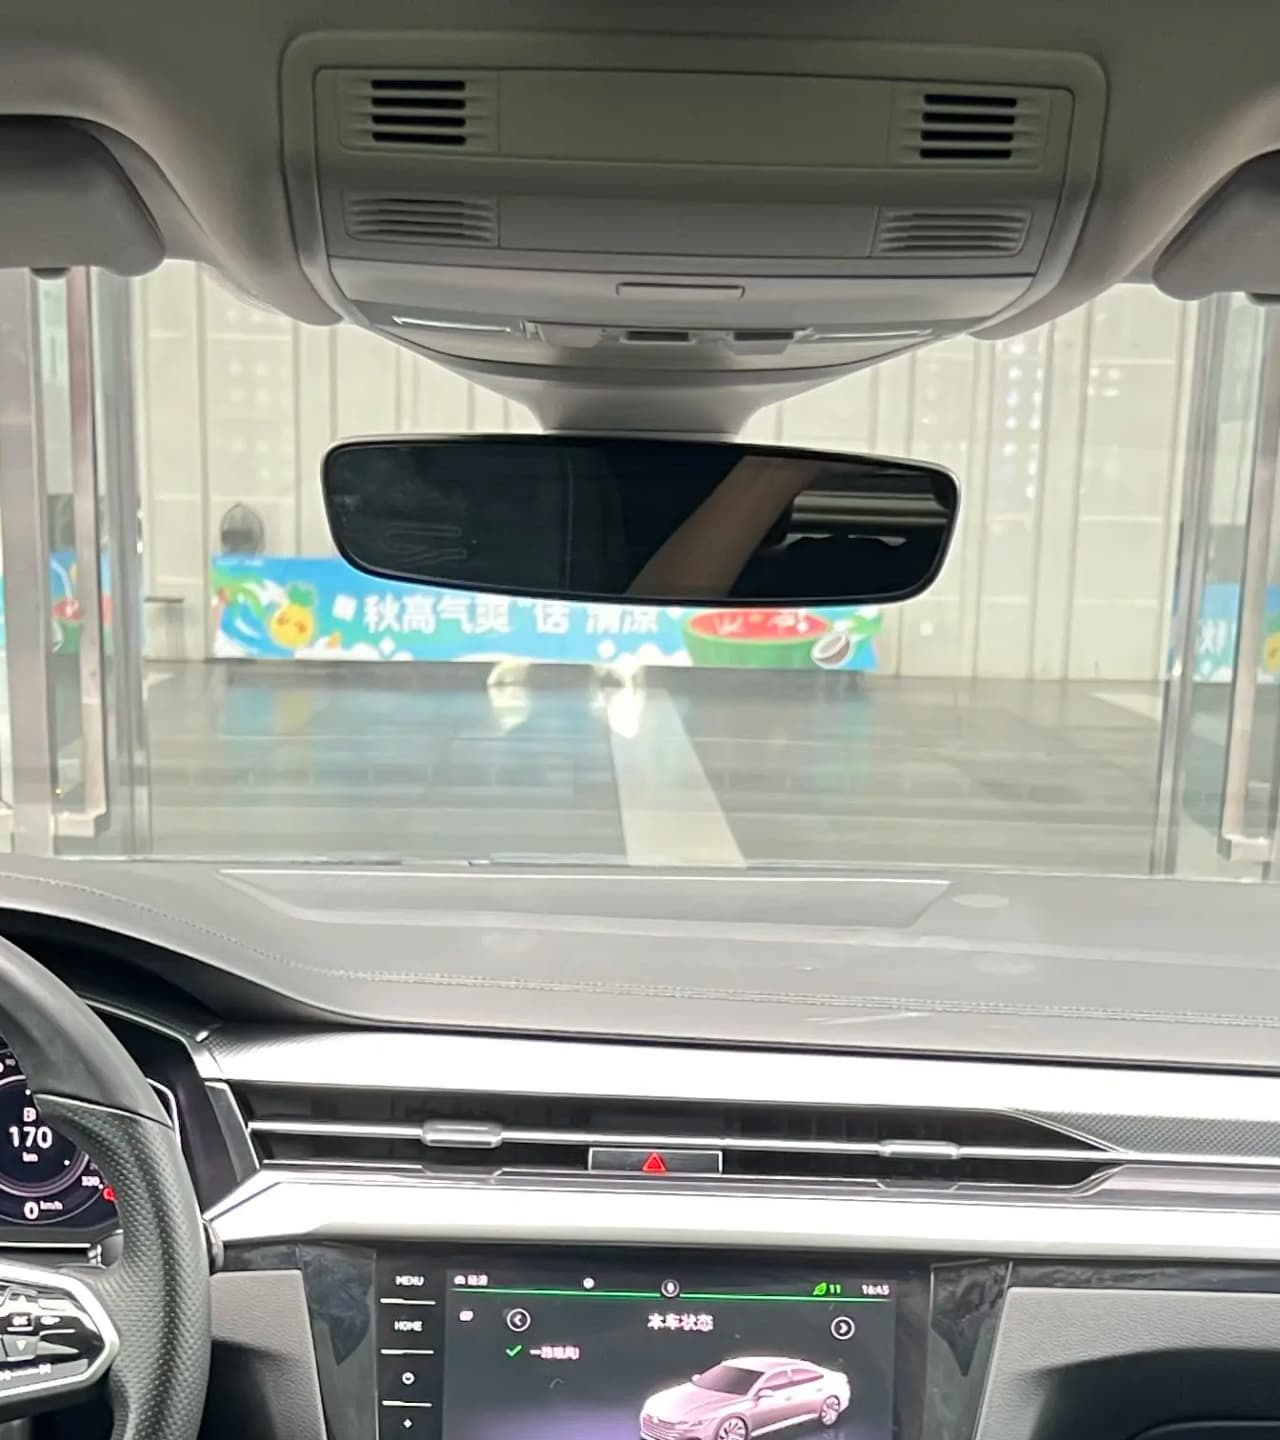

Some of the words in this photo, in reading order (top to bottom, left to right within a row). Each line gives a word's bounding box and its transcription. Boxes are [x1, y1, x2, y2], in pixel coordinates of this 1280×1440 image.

[9, 1126, 53, 1149] 170
[22, 1151, 39, 1162] km
[23, 1201, 39, 1220] 0
[40, 1200, 63, 1210] km/h
[395, 1275, 424, 1286] MENU
[829, 1284, 841, 1294] 11
[861, 1284, 890, 1295] 16:45
[394, 1320, 422, 1332] HOME
[648, 1313, 714, 1332] 本车状态
